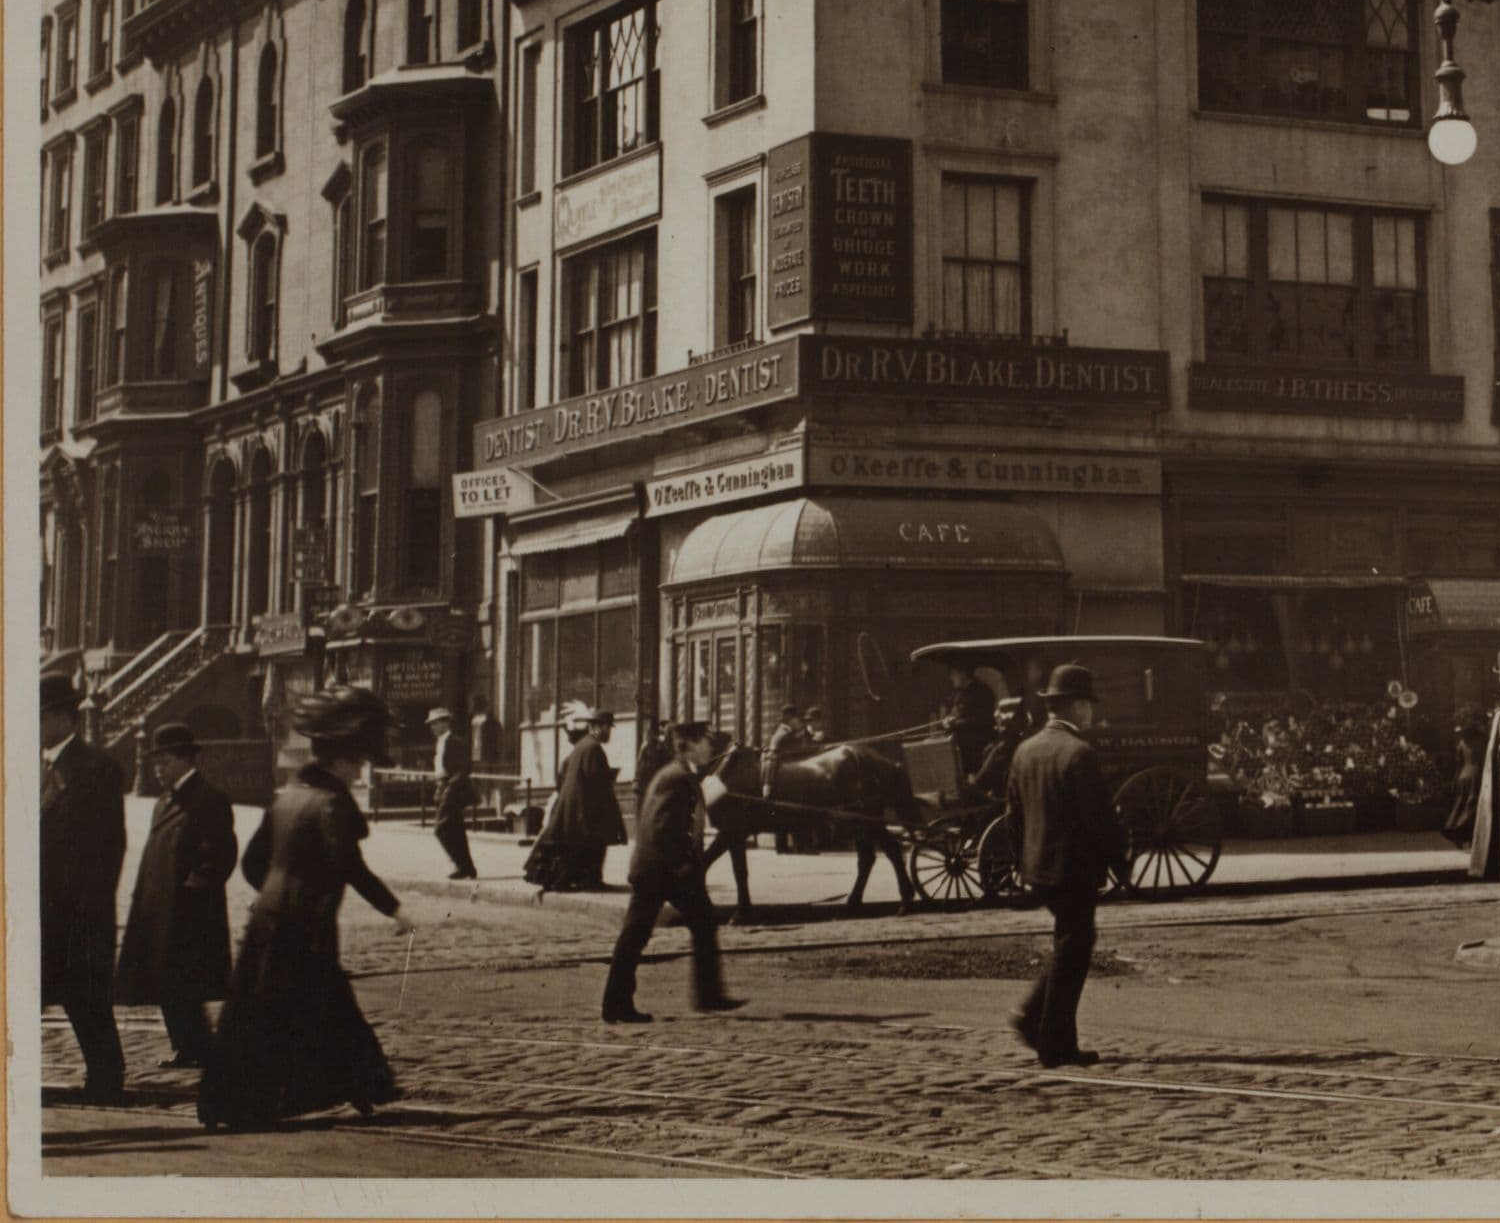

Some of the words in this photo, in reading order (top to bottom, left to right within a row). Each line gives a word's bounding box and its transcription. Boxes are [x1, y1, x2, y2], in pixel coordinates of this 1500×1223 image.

[829, 167, 897, 206] TEETH
[834, 209, 894, 227] CROWN
[832, 236, 897, 256] BRIDGE
[838, 260, 891, 278] WORK
[485, 419, 545, 462] DENTIST
[703, 353, 783, 408] DENTIST
[460, 474, 506, 490] OFFICES
[704, 478, 715, 495] &
[716, 462, 794, 495] Cunningham
[830, 455, 942, 480] O'Keeffe
[945, 458, 968, 479] &
[974, 459, 1143, 489] Cunningham
[459, 491, 479, 505] TO
[484, 486, 513, 501] LET
[898, 520, 973, 545] CAFE
[1408, 594, 1434, 617] CAFE
